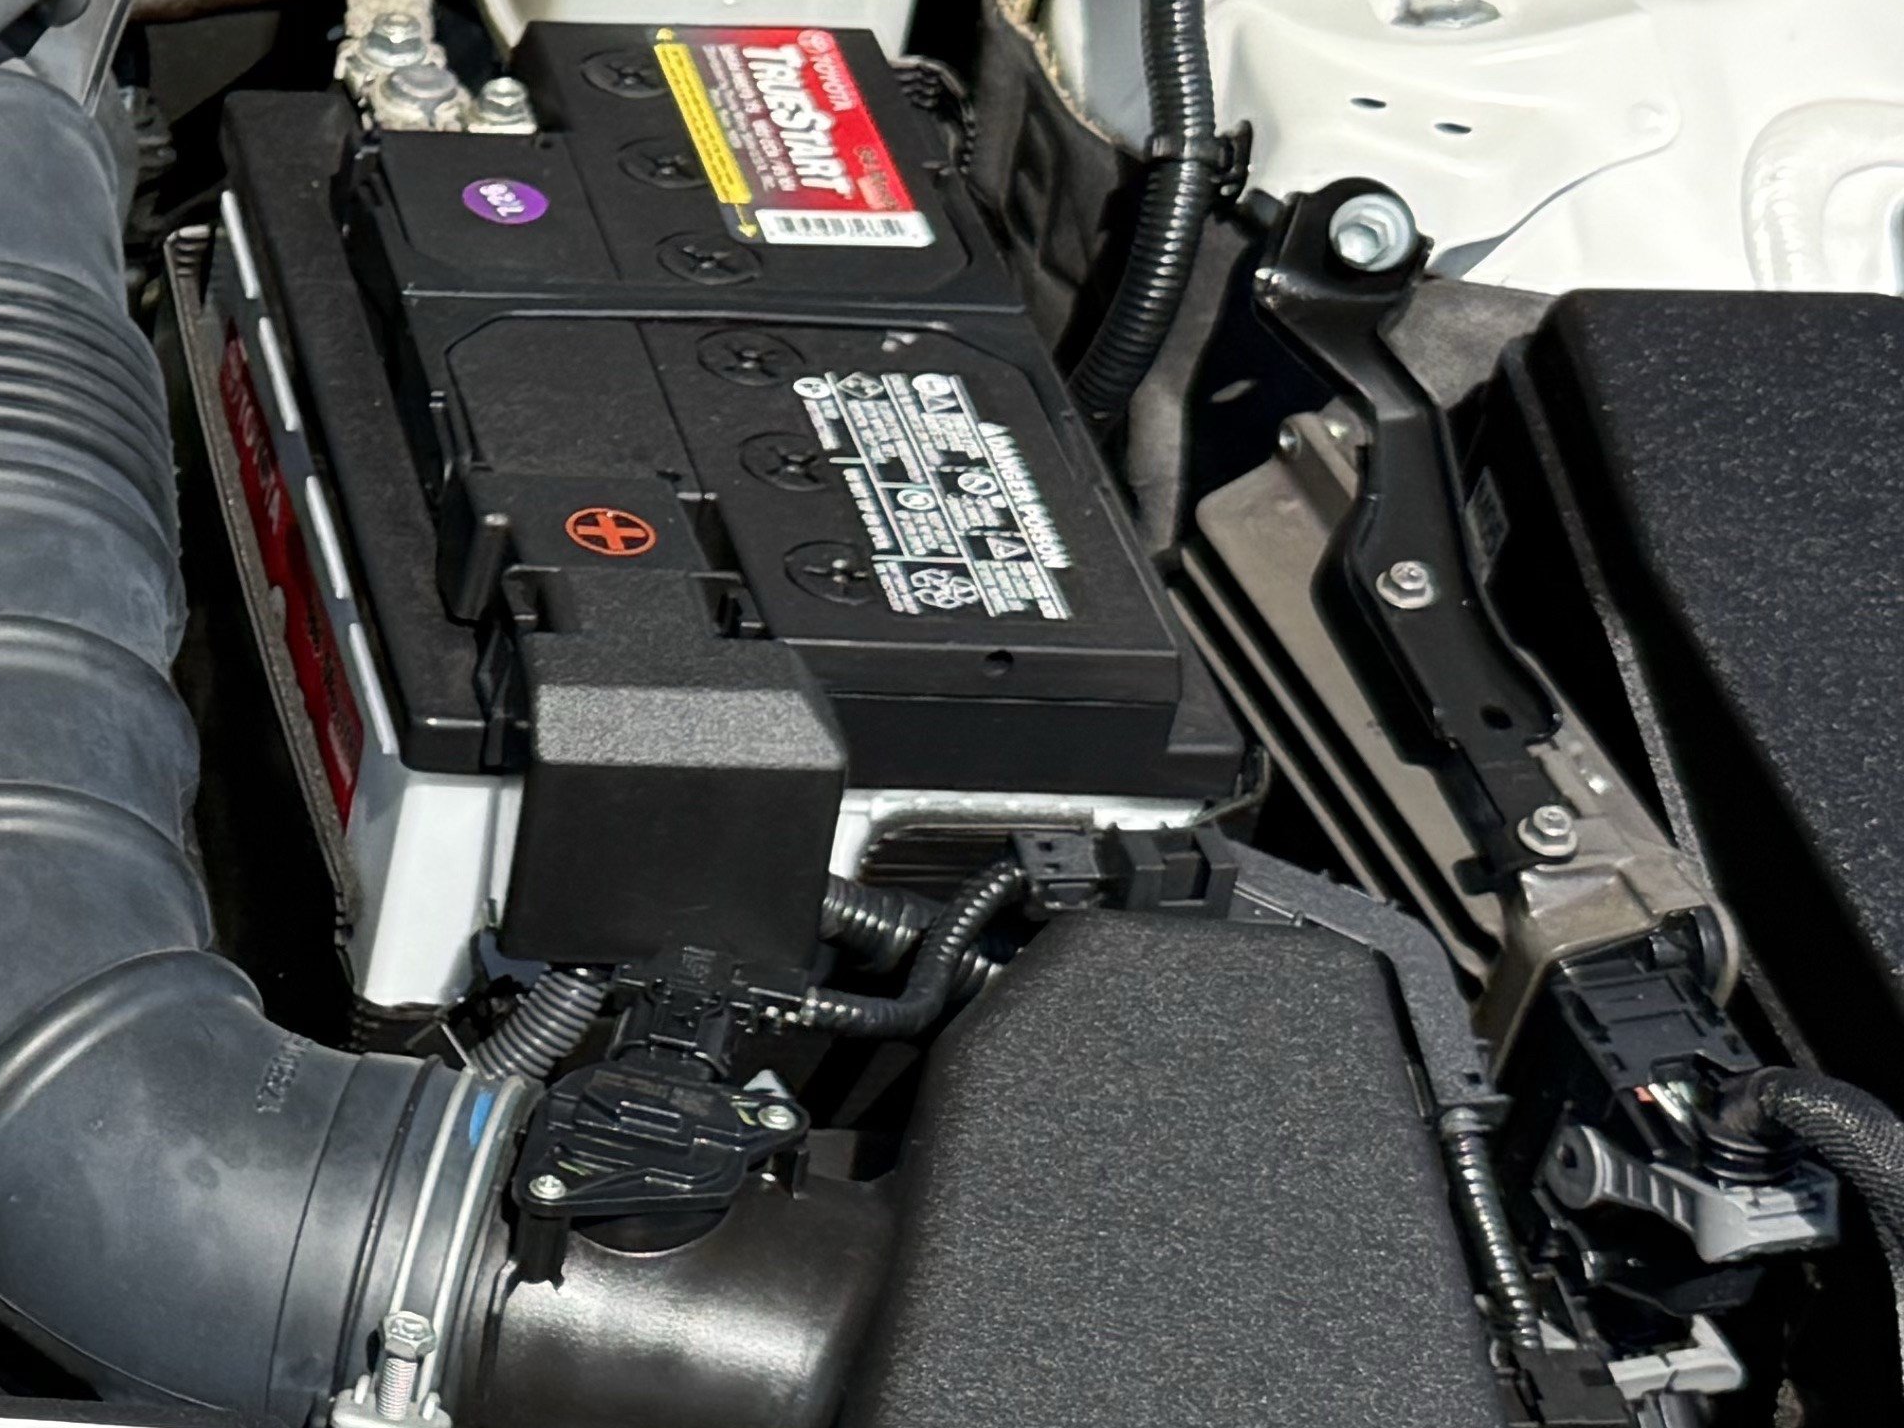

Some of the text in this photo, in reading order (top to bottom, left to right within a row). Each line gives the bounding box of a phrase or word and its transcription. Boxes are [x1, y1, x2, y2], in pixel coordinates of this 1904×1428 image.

[810, 52, 855, 112] TOYOTA
[984, 434, 1043, 503] DANGER
[1019, 502, 1073, 569] POISON
